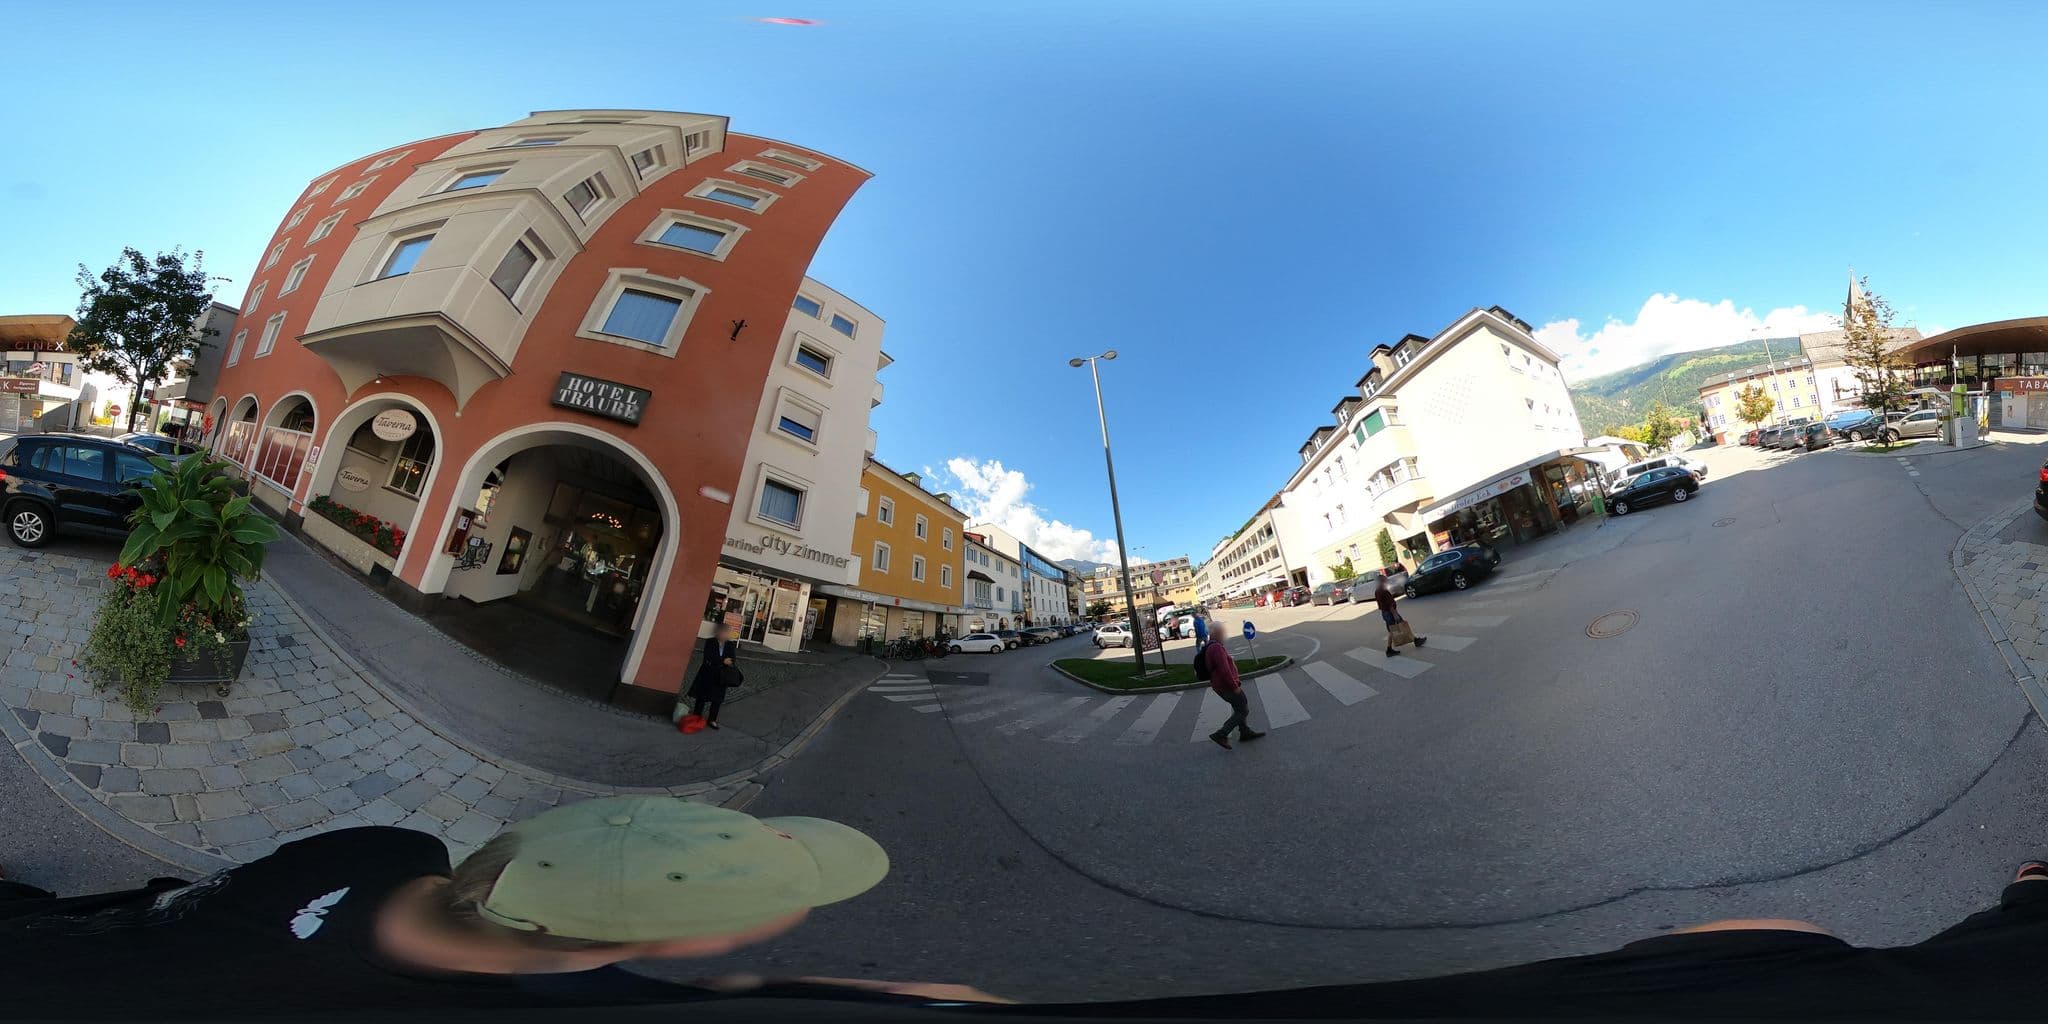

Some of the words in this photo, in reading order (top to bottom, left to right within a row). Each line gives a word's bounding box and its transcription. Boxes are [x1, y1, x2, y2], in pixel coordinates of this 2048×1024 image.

[15, 341, 64, 351] CINEX
[568, 377, 638, 405] HOTEL
[559, 388, 640, 420] TRAUBE
[378, 416, 412, 431] Taverna
[342, 471, 369, 485] Taverna
[724, 537, 765, 555] ariner
[761, 534, 792, 556] city
[793, 544, 850, 569] zimmer
